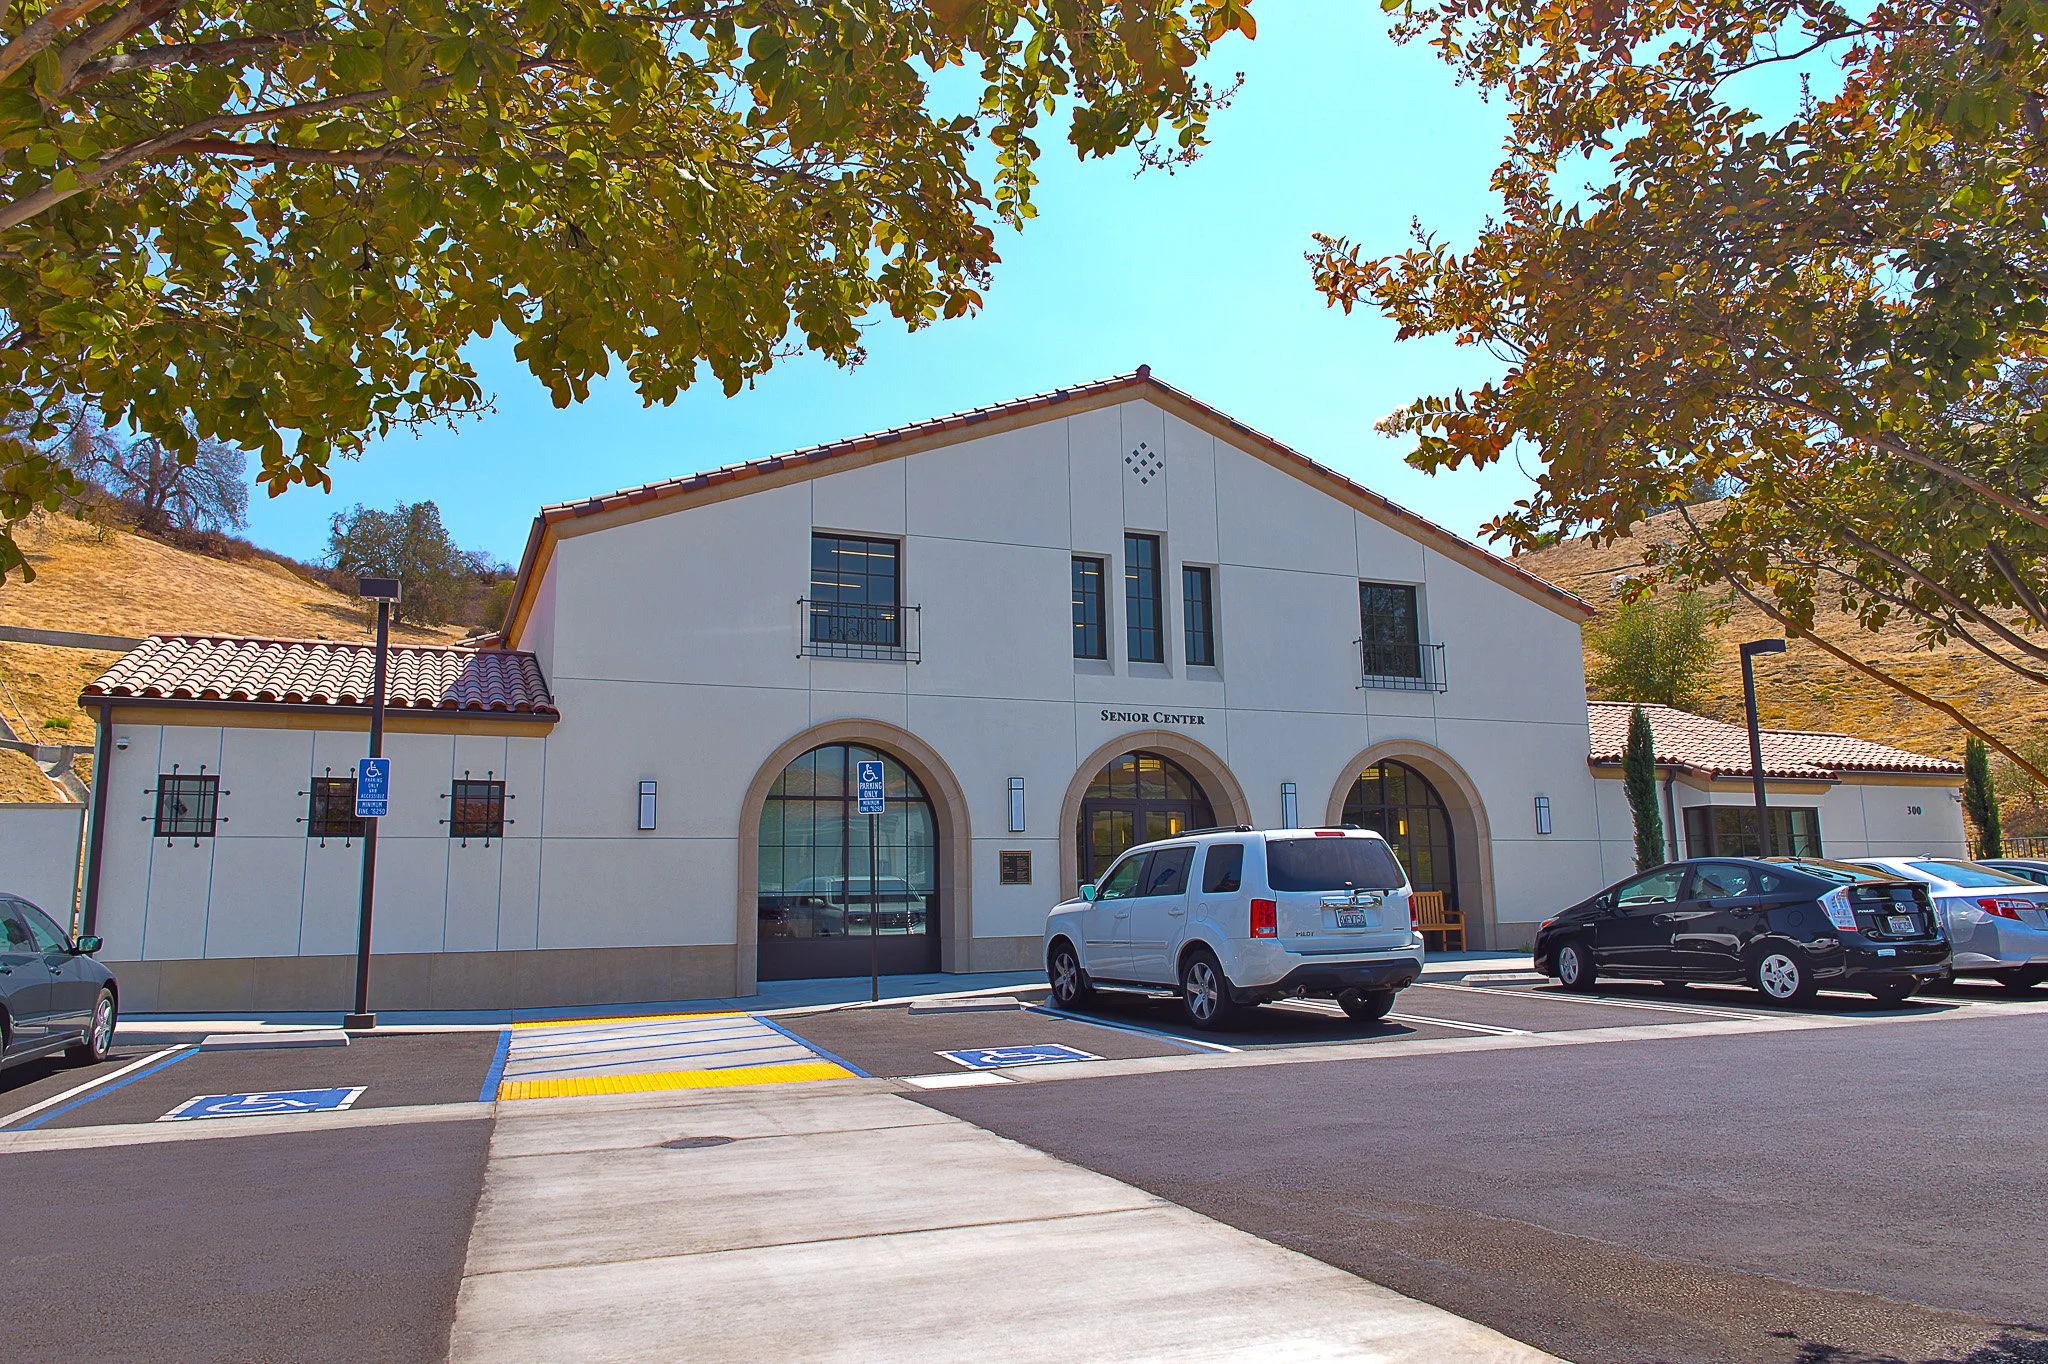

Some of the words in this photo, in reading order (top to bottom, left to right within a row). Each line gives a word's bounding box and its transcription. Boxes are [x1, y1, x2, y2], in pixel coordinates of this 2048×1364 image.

[1101, 710, 1150, 722] SENIOR
[1153, 712, 1205, 724] CENTER
[1907, 806, 1921, 815] 300
